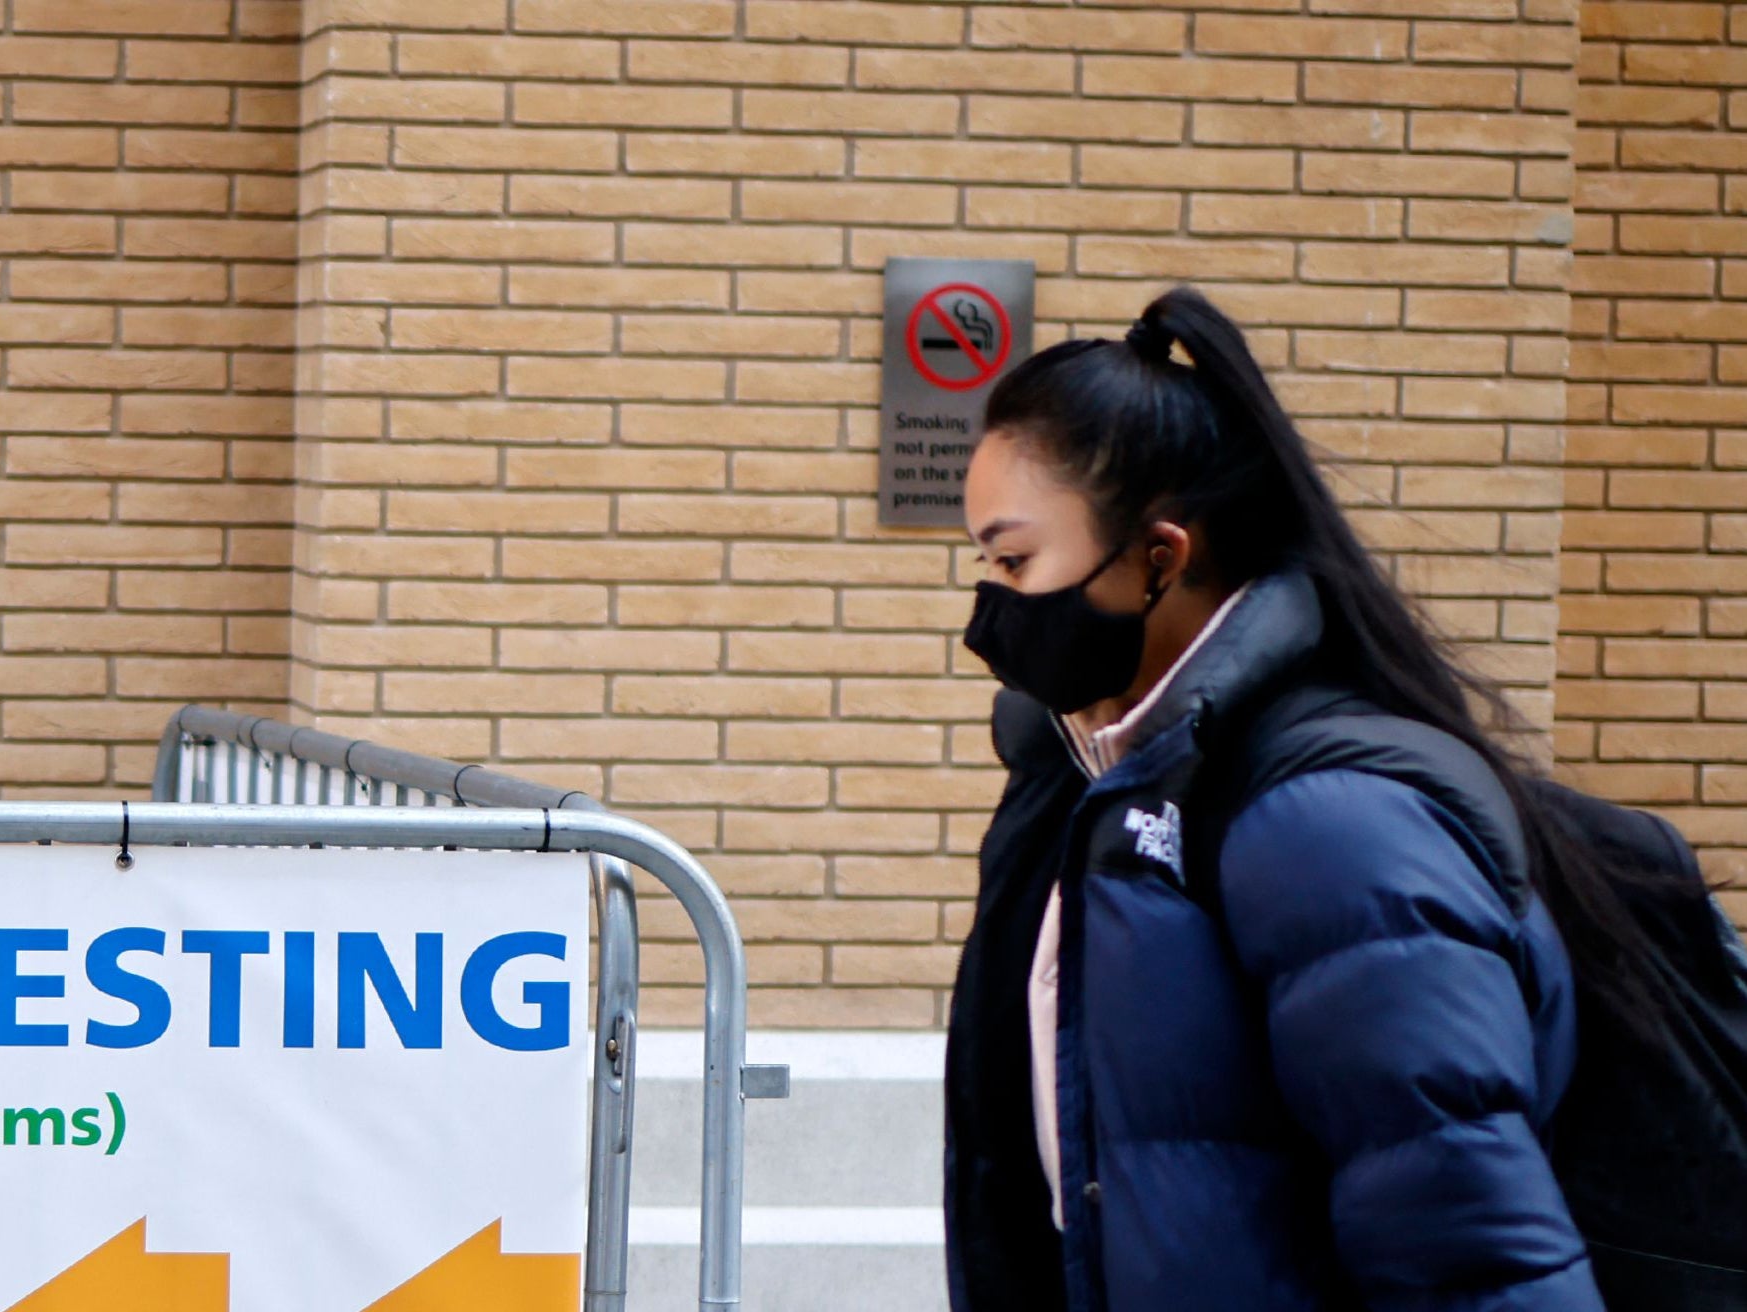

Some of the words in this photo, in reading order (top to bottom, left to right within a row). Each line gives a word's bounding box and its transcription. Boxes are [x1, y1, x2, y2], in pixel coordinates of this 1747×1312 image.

[896, 411, 970, 435] Smoking
[895, 441, 924, 455] not
[894, 468, 917, 480] on
[921, 466, 950, 481] the
[893, 490, 964, 508] premise
